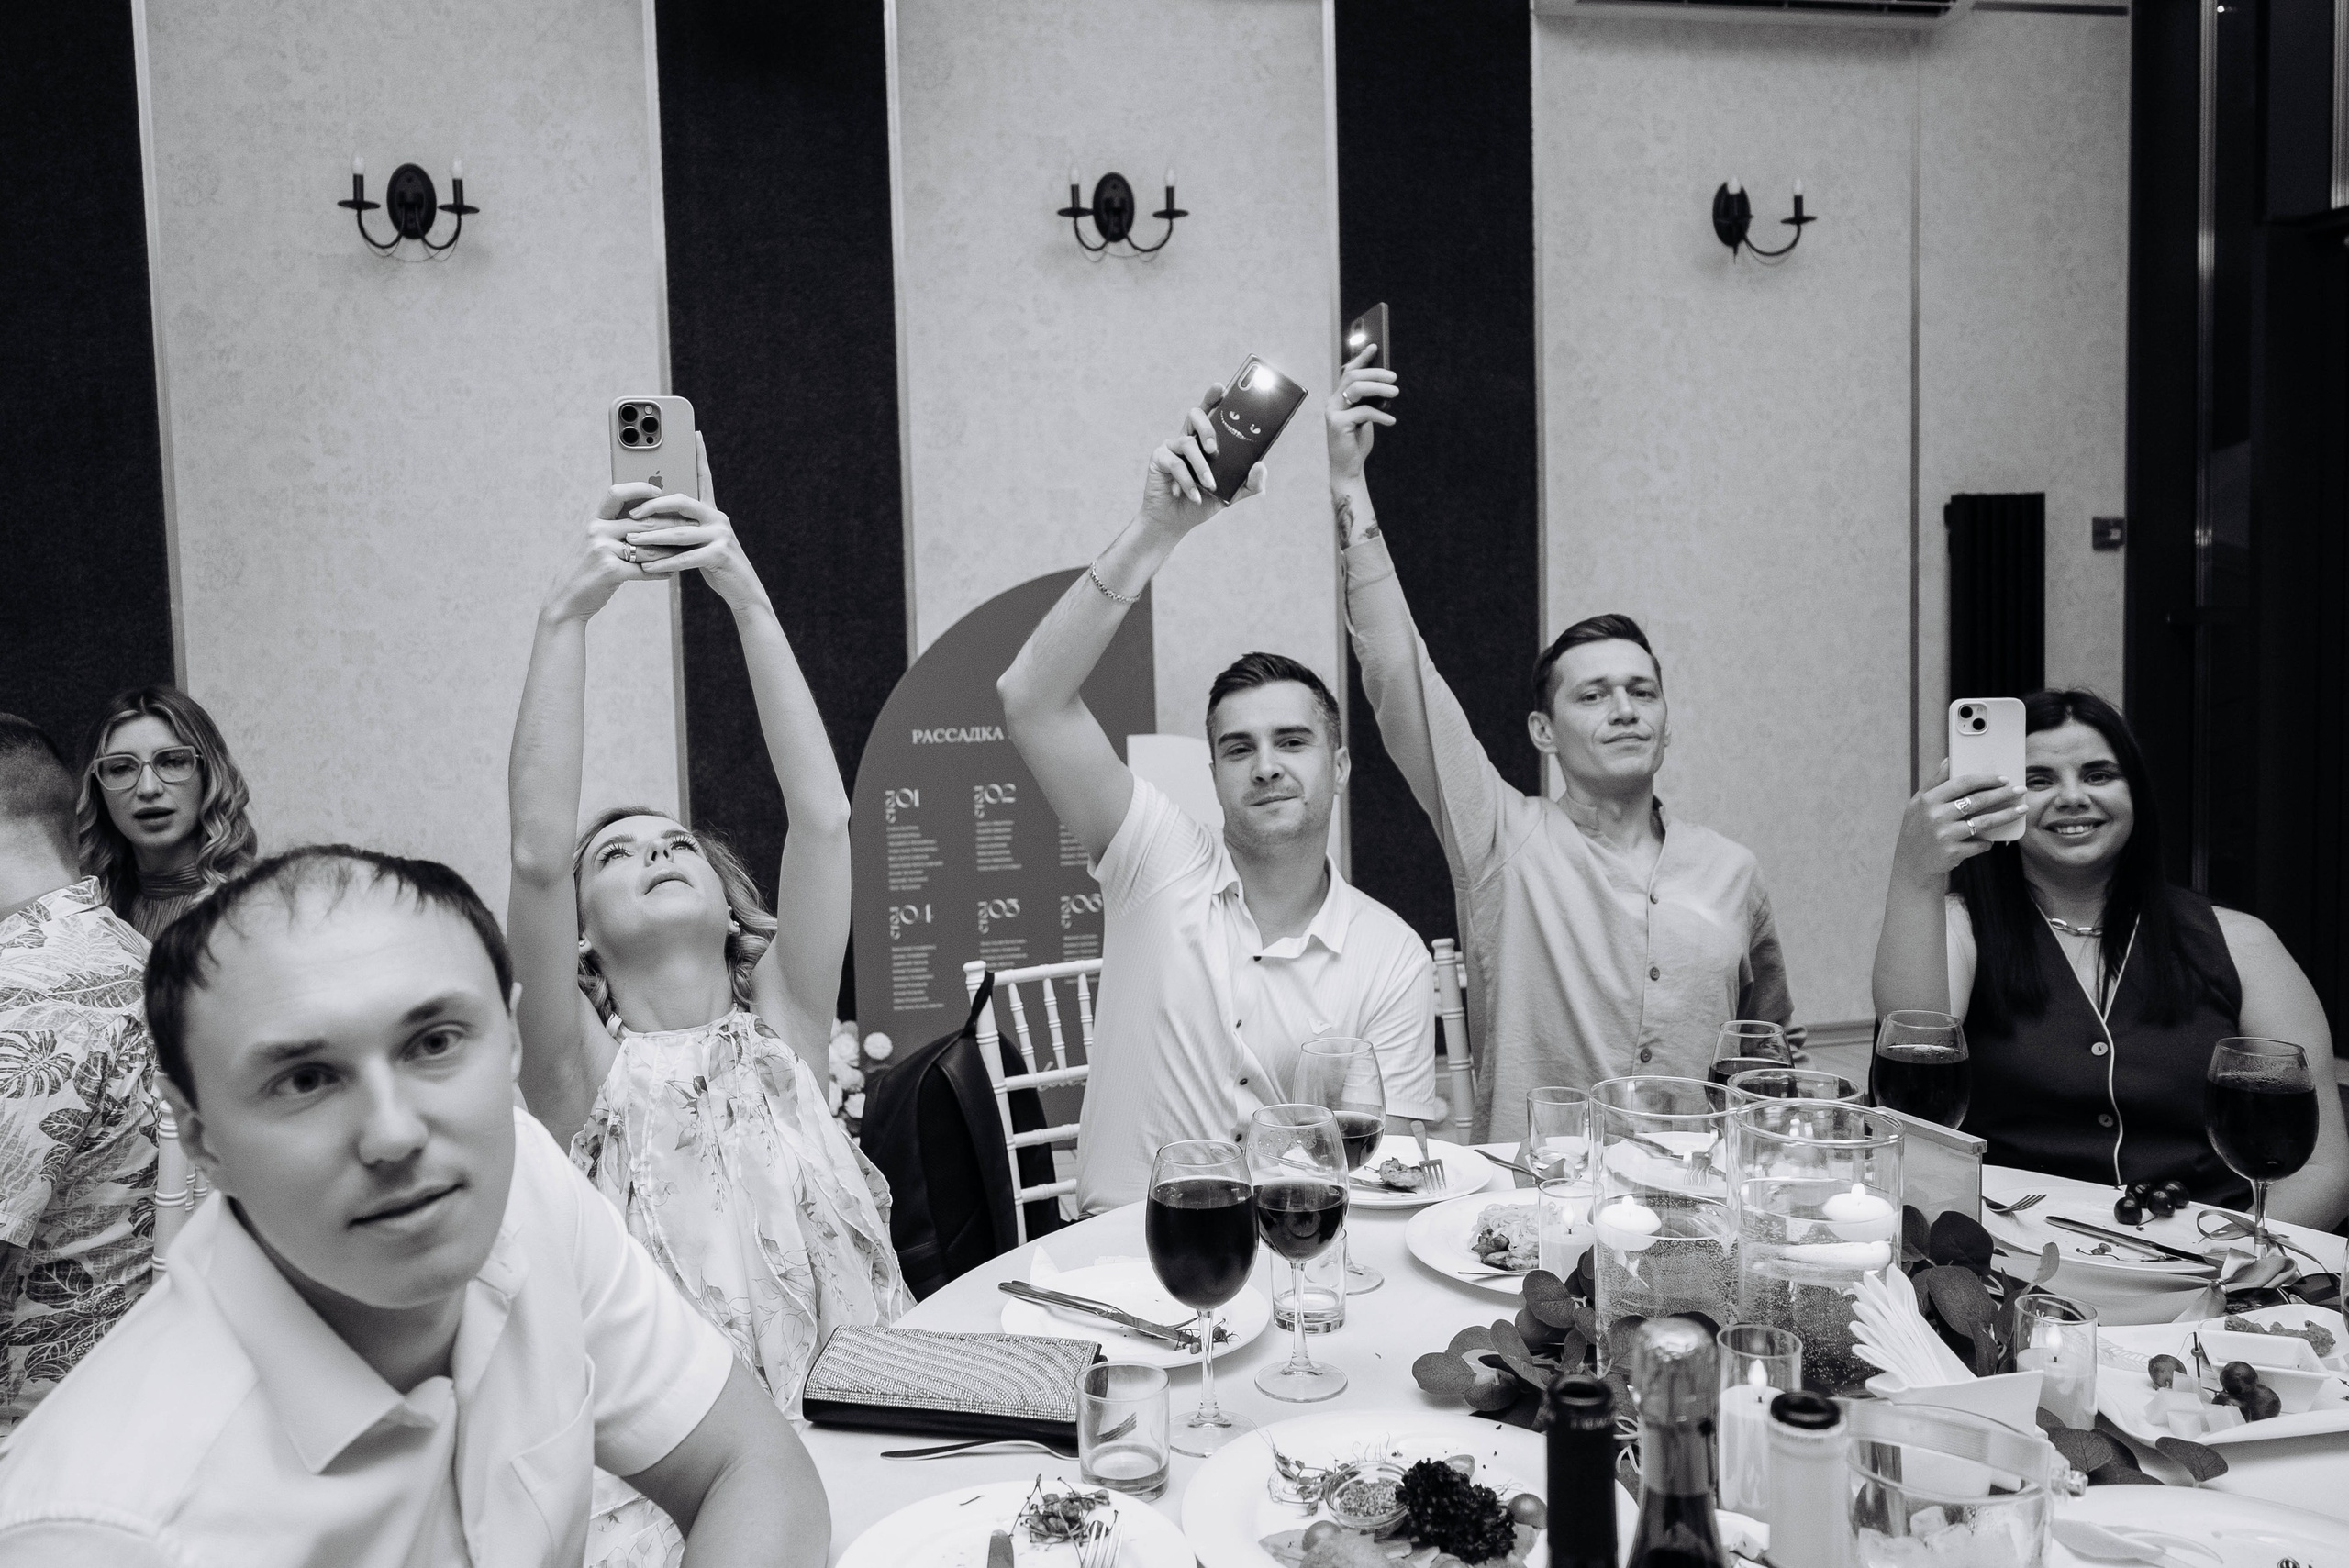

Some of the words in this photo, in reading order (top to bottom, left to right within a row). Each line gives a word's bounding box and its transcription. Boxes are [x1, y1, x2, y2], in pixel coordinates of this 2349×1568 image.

[912, 726, 1005, 744] РАССАДКА
[896, 788, 919, 808] 01
[984, 783, 1016, 804] 02
